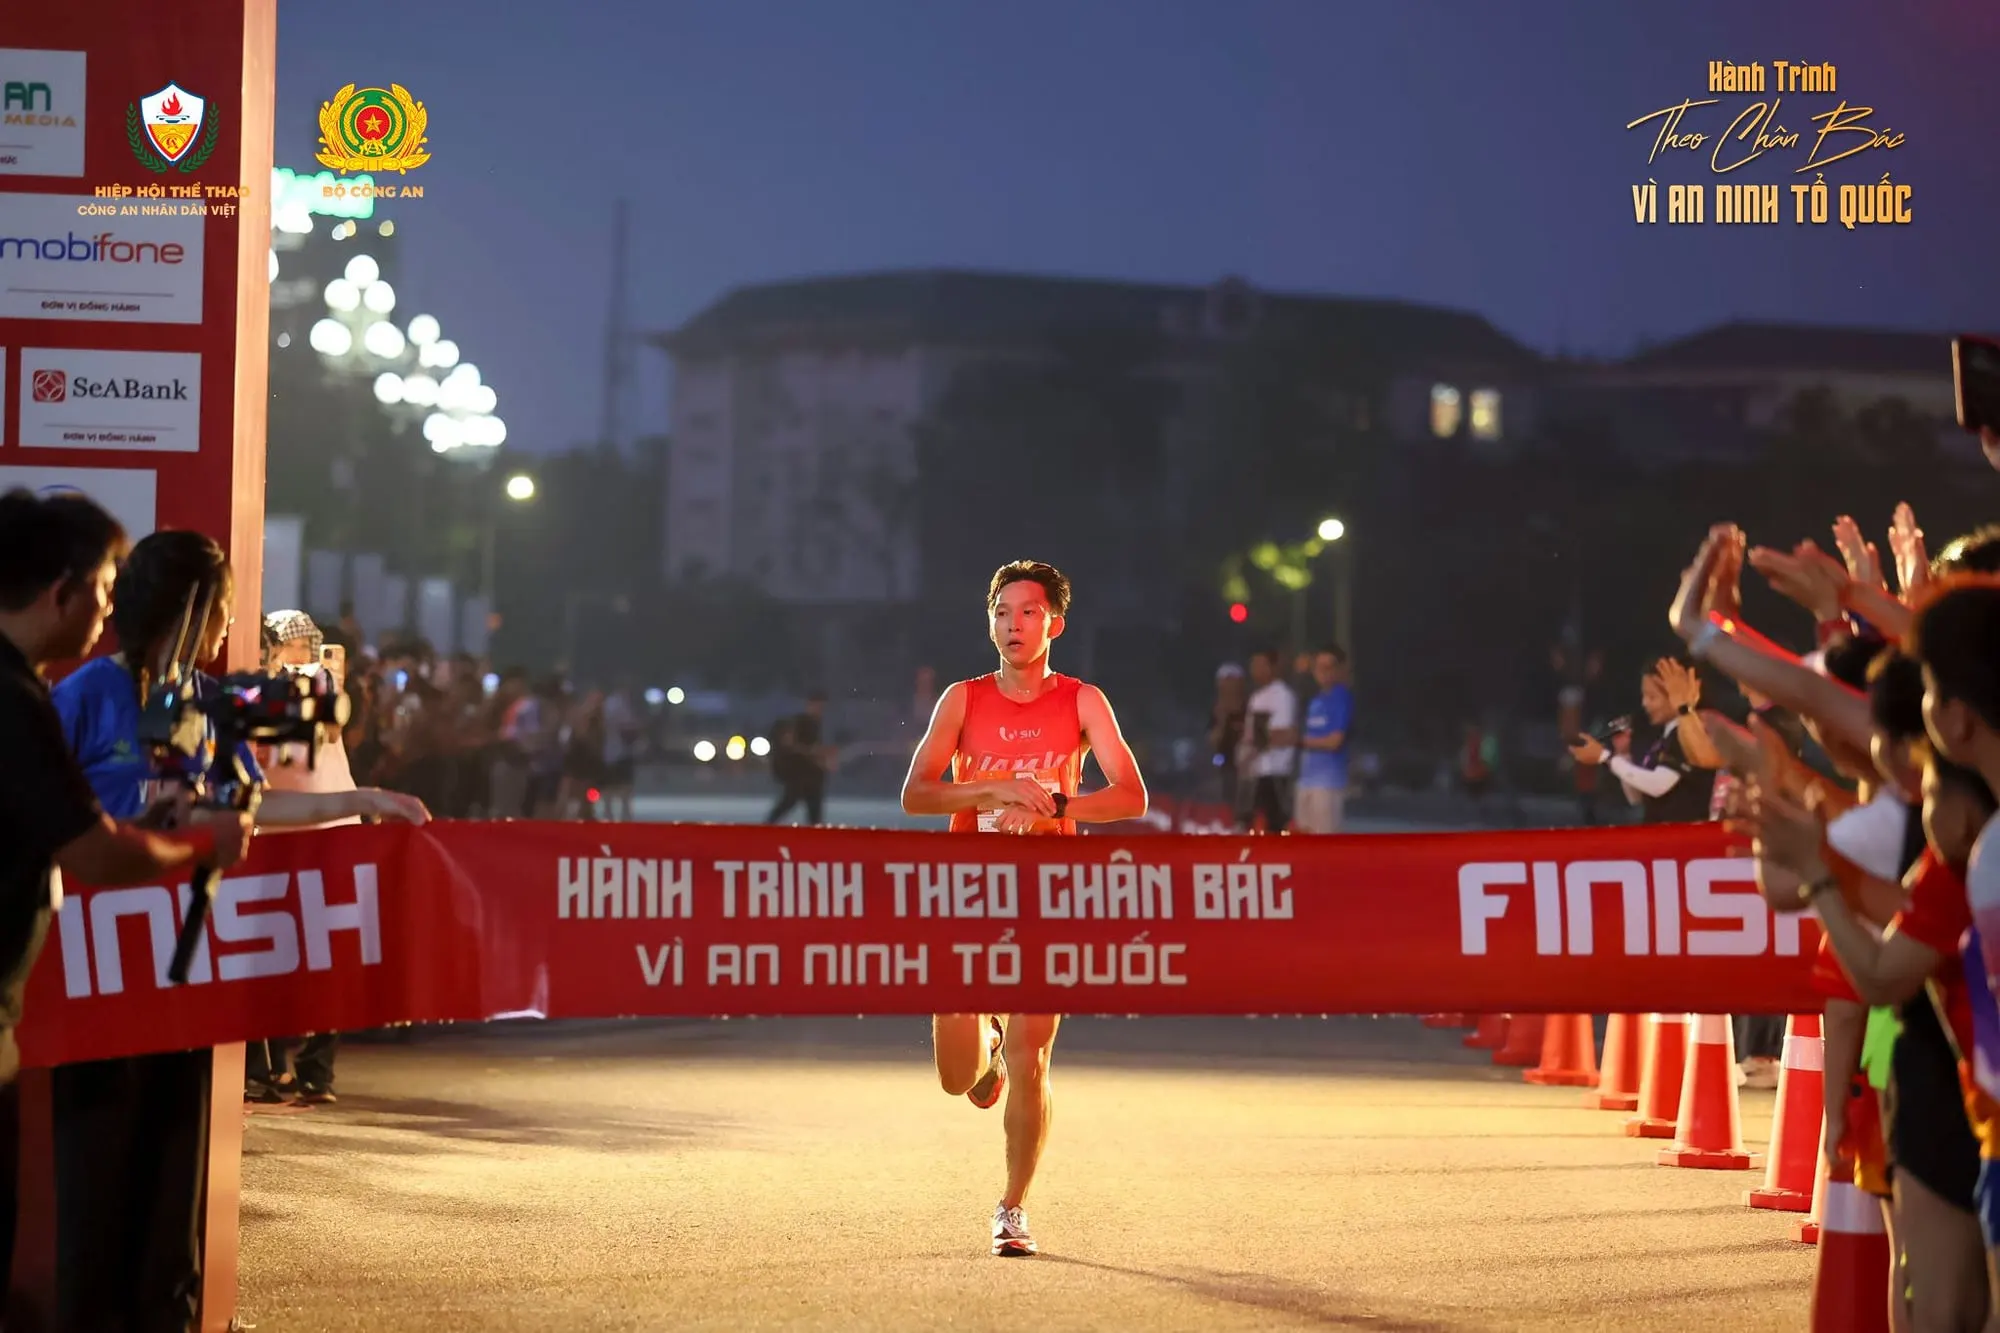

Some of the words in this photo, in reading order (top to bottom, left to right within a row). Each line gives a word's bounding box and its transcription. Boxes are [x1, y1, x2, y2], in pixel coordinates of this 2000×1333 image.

[4, 114, 78, 128] MEDIA
[0, 231, 184, 264] mobifone
[72, 377, 188, 401] SeABank
[557, 845, 693, 919] HÀNH
[714, 847, 863, 919] TRÌNH
[884, 861, 1019, 919] THEO
[1039, 848, 1173, 919] CHÂN
[1193, 848, 1295, 919] BÁC
[57, 863, 382, 999] INISH
[635, 937, 685, 985] VÌ
[707, 944, 780, 985] AN
[803, 944, 928, 985] NINH
[952, 929, 1022, 985] TỔ
[1045, 931, 1187, 987] QUỐC
